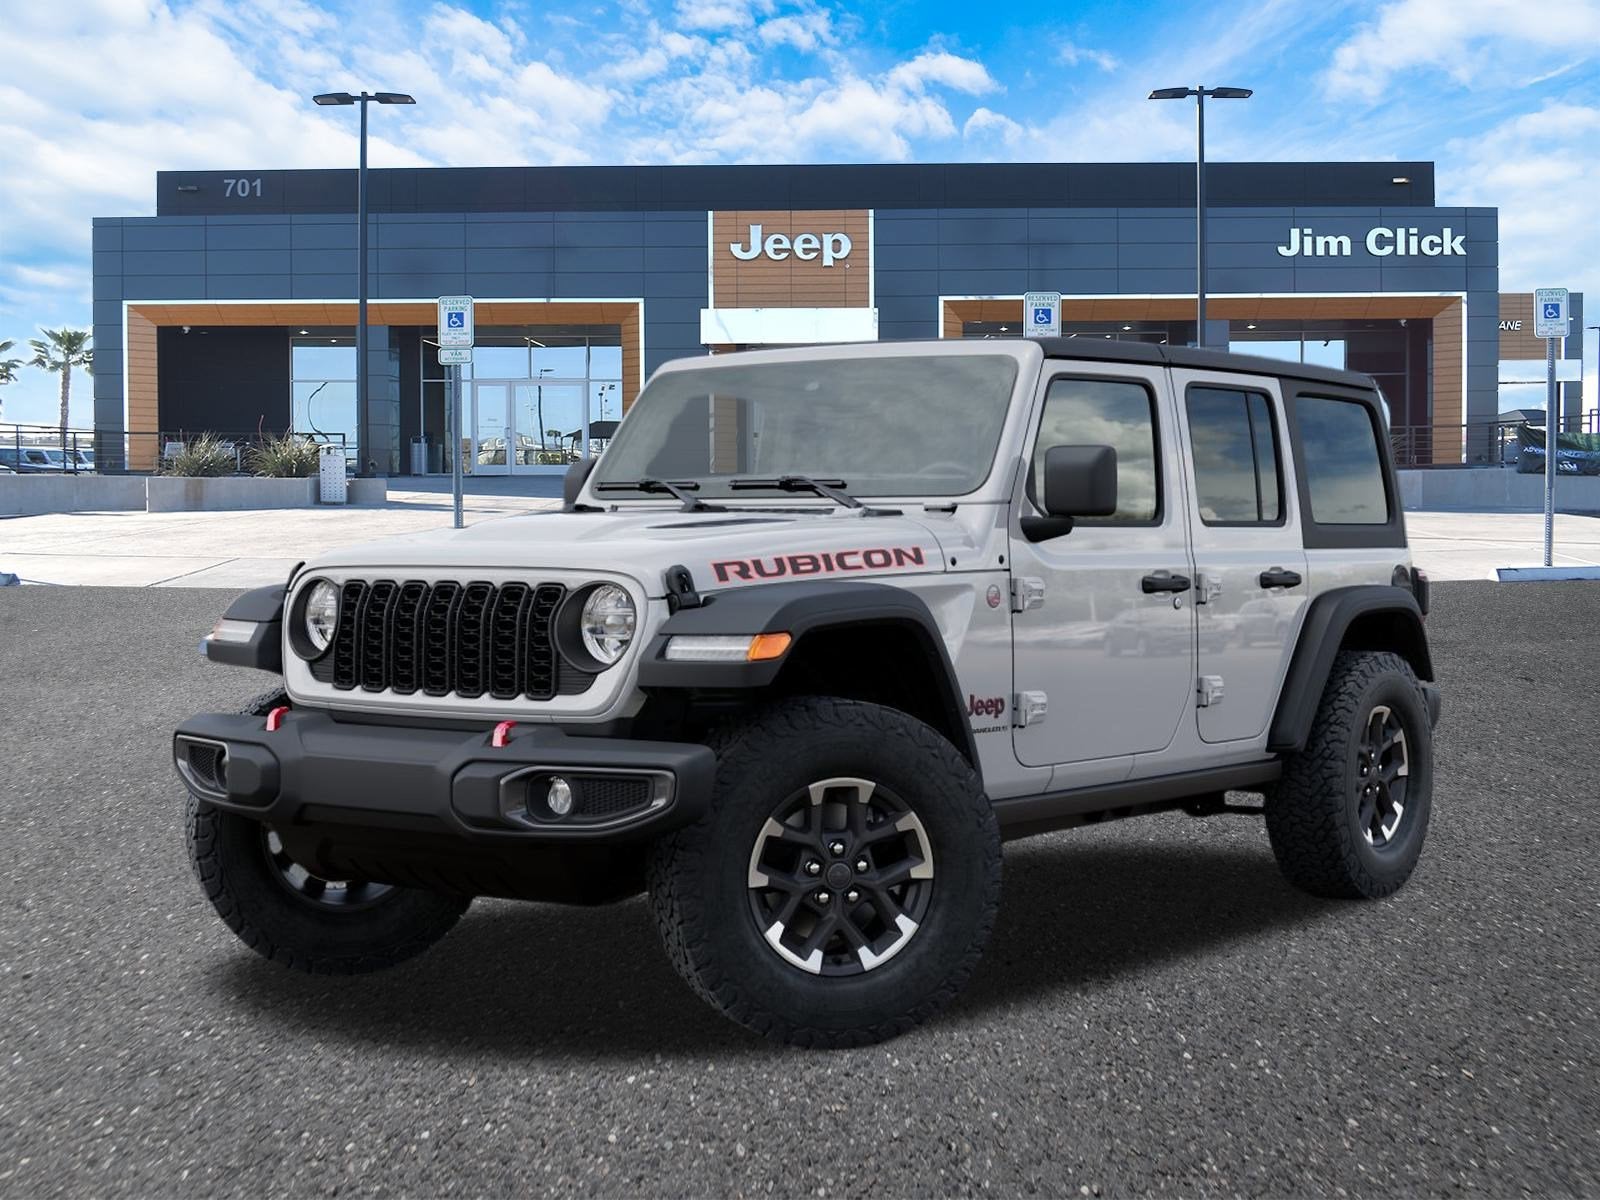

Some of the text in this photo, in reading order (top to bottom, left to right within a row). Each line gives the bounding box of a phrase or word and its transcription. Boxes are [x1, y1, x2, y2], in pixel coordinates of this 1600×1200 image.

[224, 178, 262, 197] 701
[730, 224, 851, 267] Jeep
[1277, 227, 1467, 257] Jim Click
[712, 547, 925, 582] RUBICON
[967, 694, 1005, 719] Jeep
